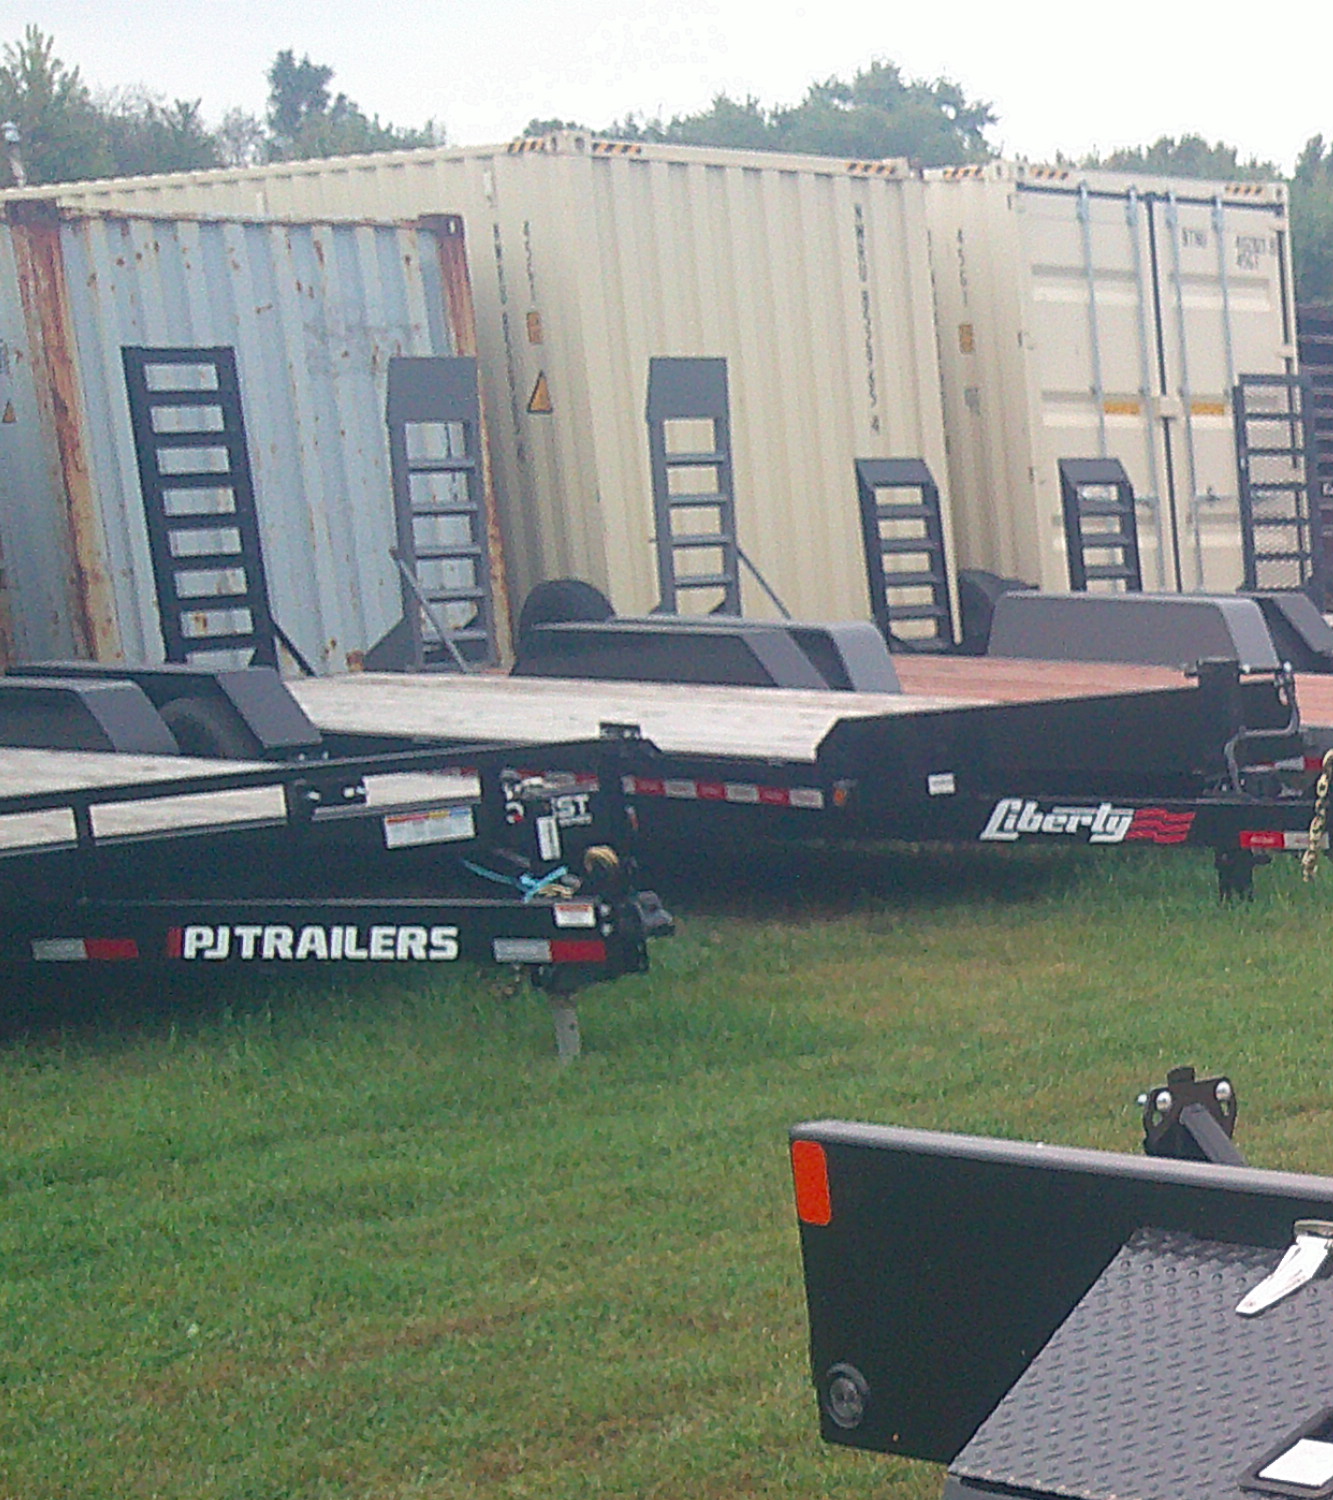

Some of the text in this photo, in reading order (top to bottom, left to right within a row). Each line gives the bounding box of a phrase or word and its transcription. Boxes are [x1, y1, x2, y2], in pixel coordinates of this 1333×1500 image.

[979, 798, 1135, 843] Liberty
[184, 925, 459, 961] PJ TRAILERS
